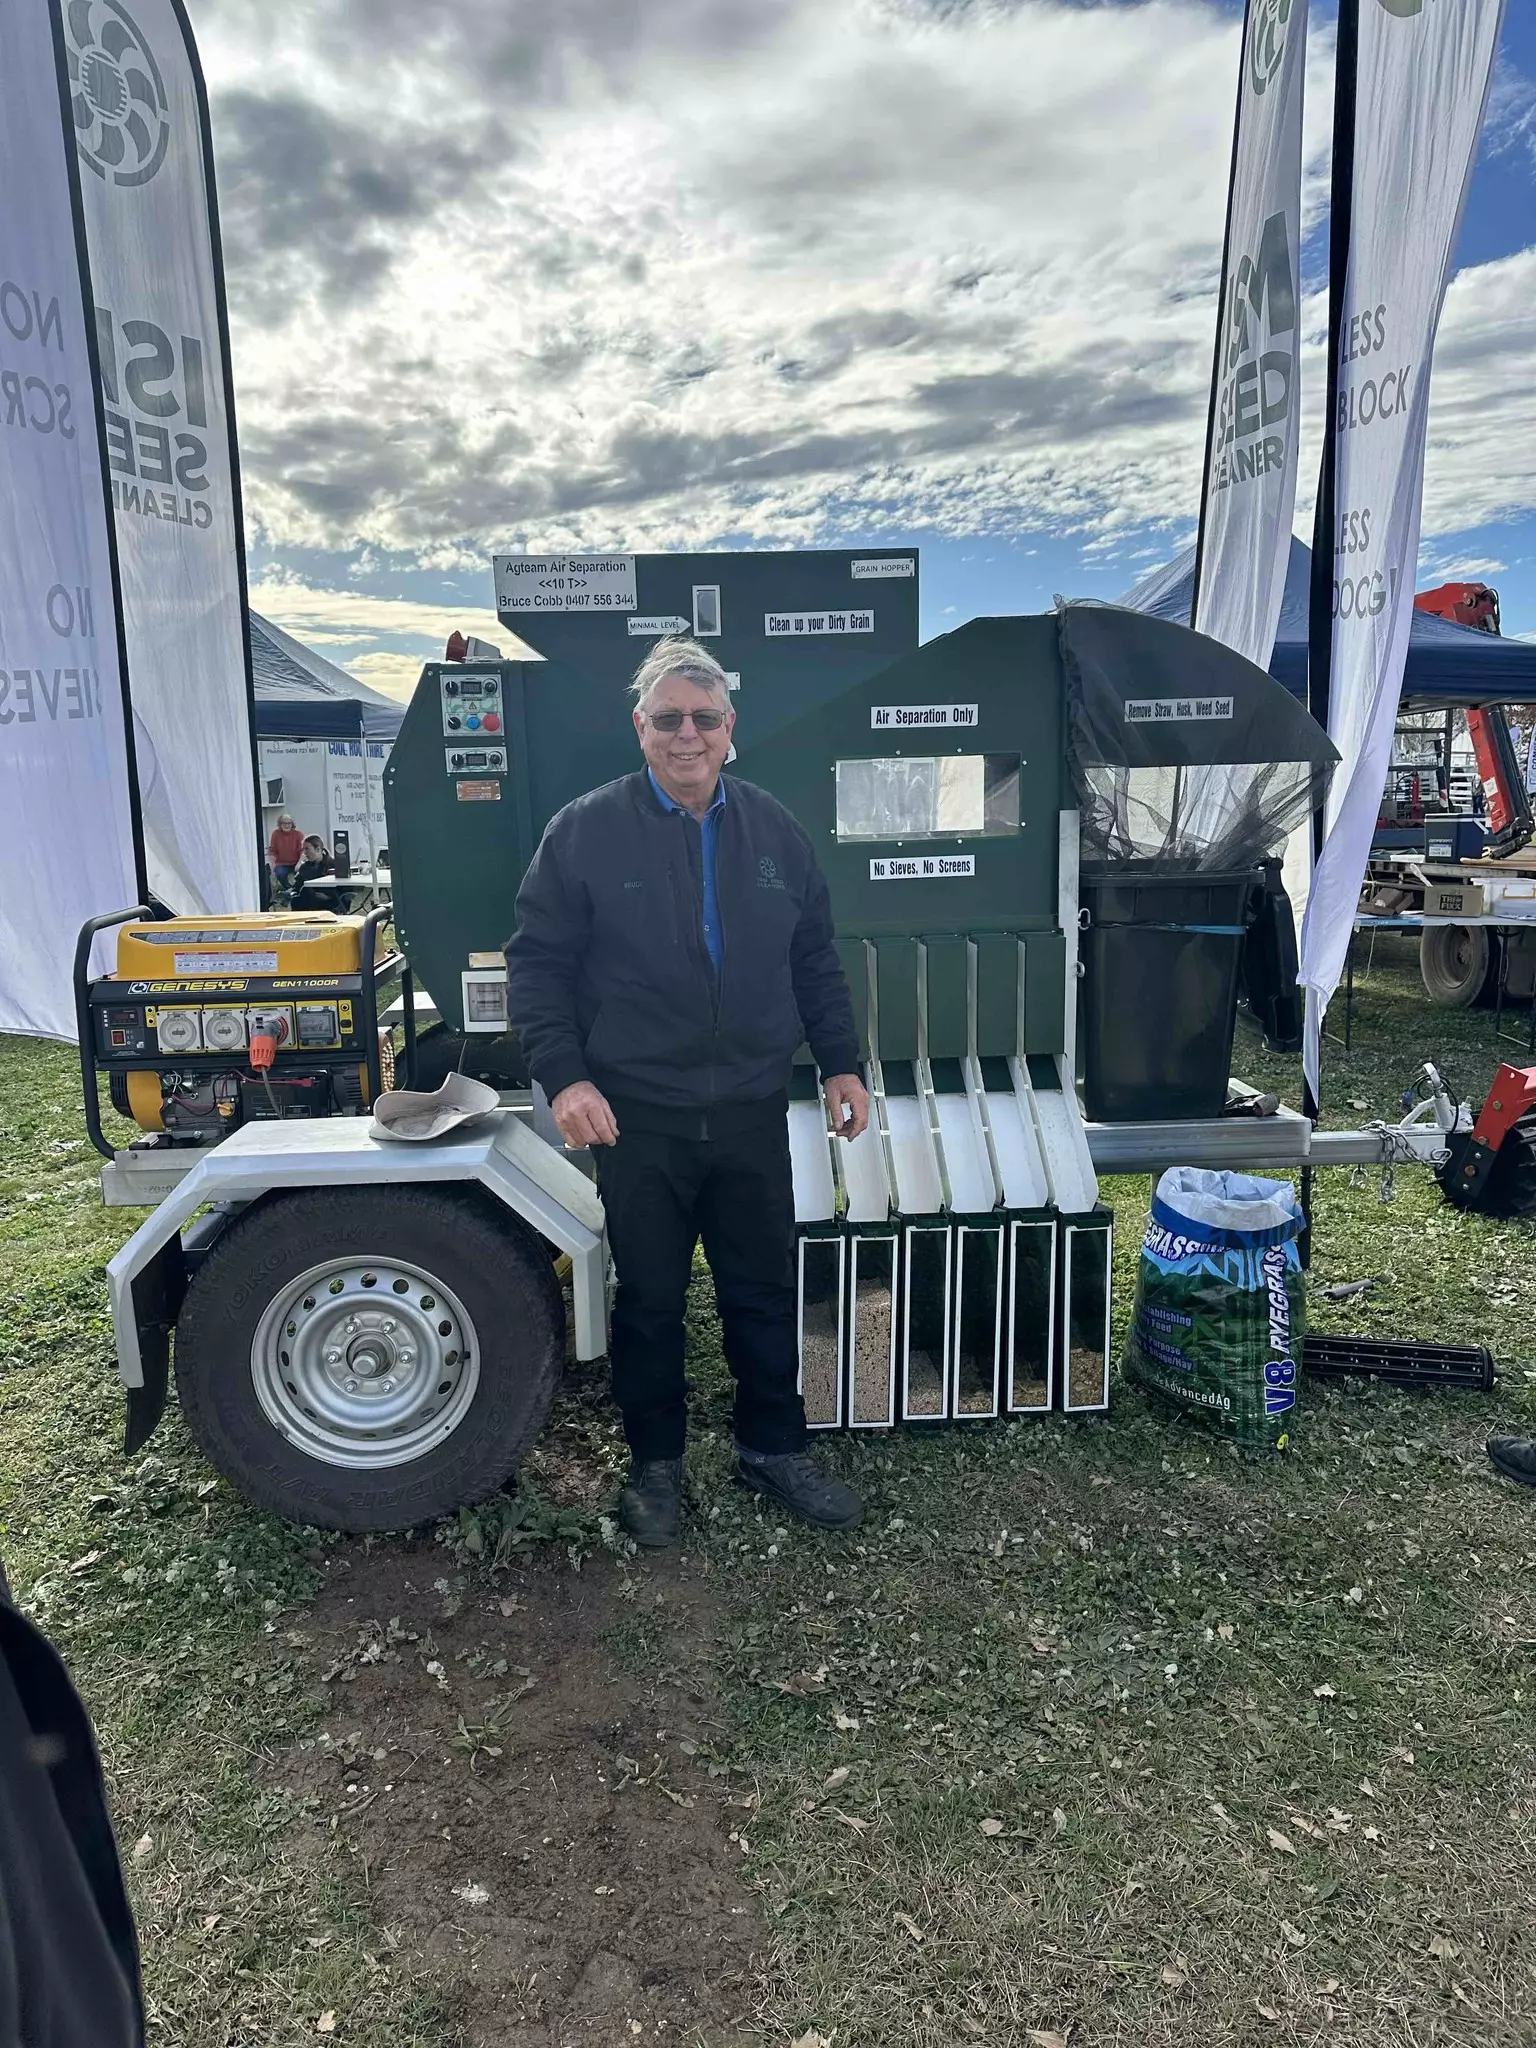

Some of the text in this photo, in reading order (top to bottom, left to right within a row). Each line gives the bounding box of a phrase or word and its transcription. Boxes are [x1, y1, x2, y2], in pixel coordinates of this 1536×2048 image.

[1341, 303, 1387, 365] LESS
[1337, 364, 1412, 434] BLOCK
[505, 561, 627, 576] Agteam Air Separation
[856, 564, 911, 573] GRAIN HOPPER
[499, 594, 634, 607] Bruce Cobb 0407 556 344
[630, 621, 681, 630] MINIMAL LEVEL
[769, 613, 870, 633] Clean up your Dirty Grain
[875, 707, 974, 726] Air Separation Only
[1128, 703, 1152, 719] Remove
[1215, 700, 1230, 716] Seed
[874, 859, 971, 876] No Sieves, No Screens
[149, 979, 339, 993] GENESYS GEN11000R
[1263, 1359, 1296, 1415] V8
